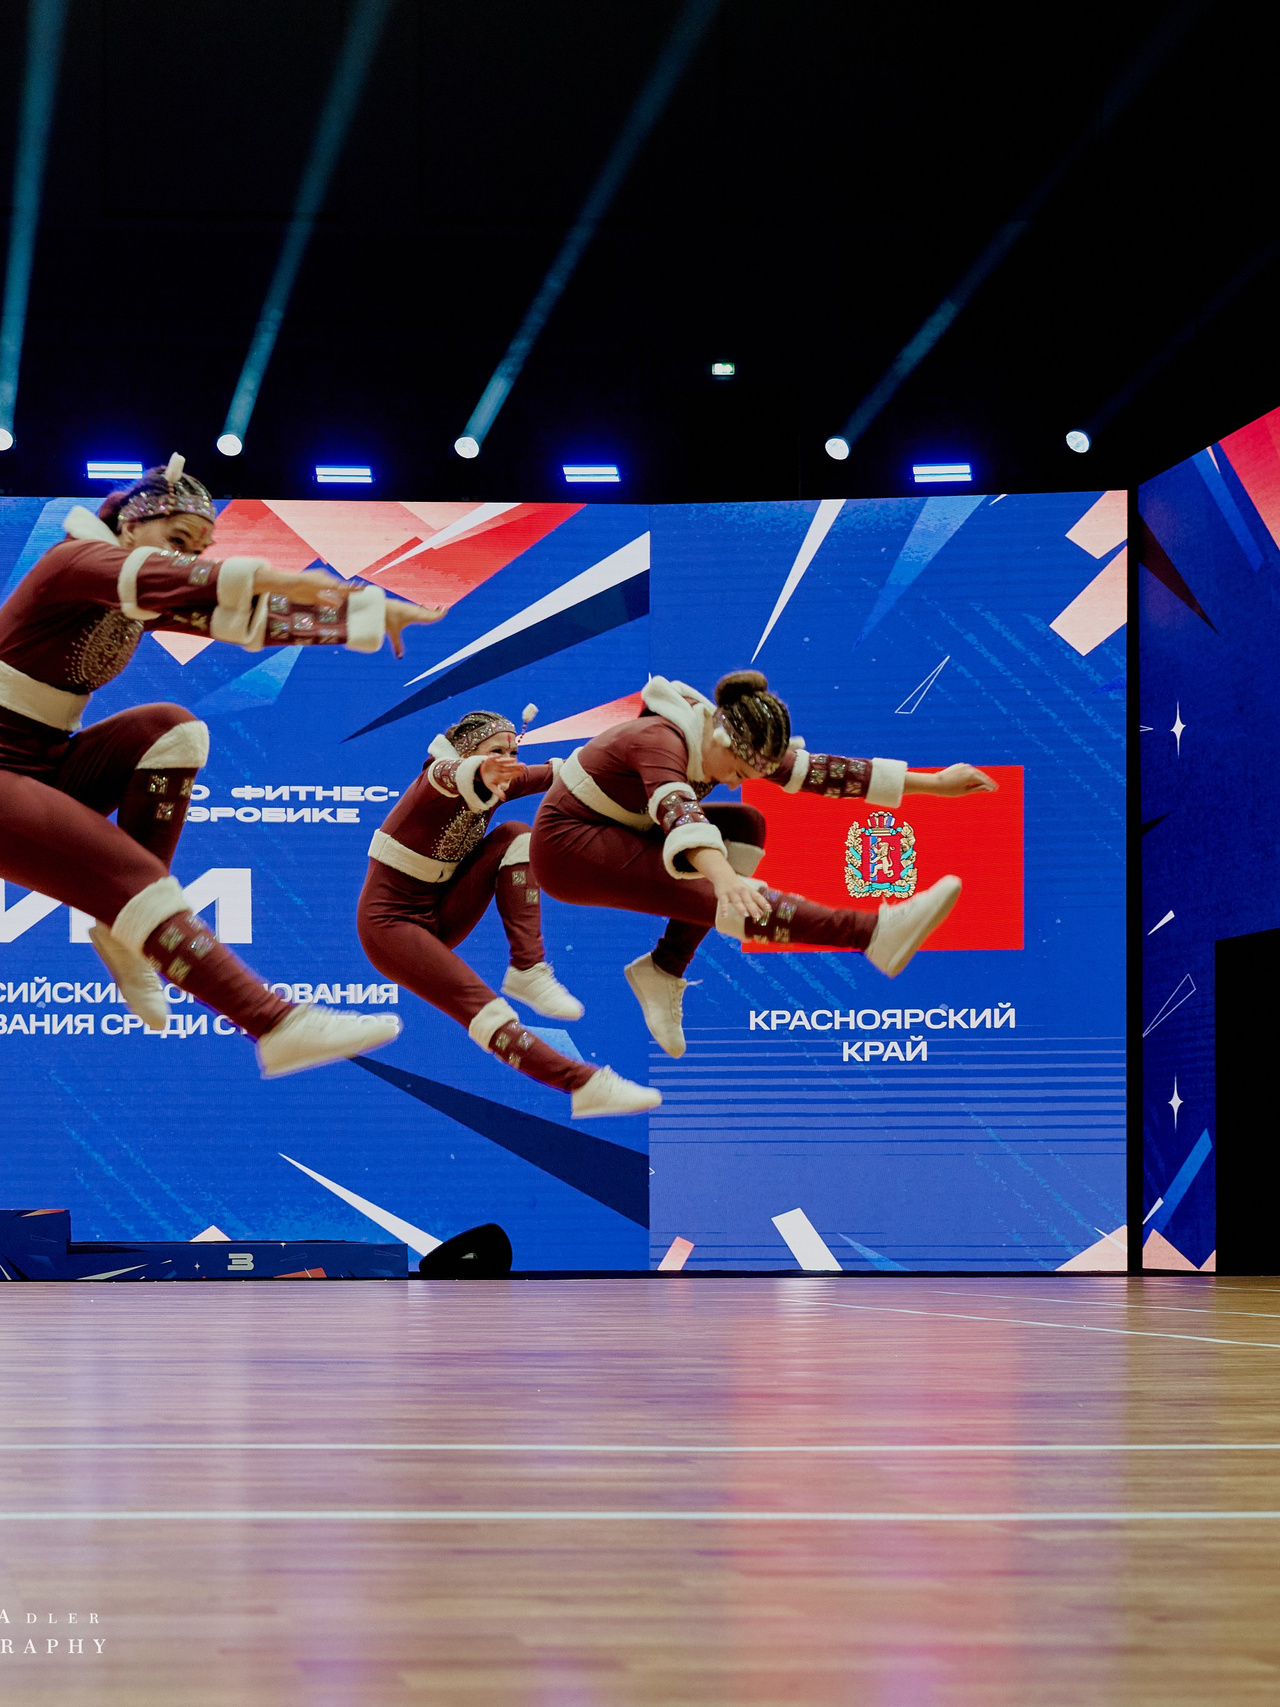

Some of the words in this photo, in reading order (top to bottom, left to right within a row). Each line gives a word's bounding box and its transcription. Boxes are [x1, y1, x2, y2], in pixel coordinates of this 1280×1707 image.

[231, 785, 400, 802] ФИТНЕС-
[184, 806, 360, 823] ЭРОБИКЕ
[749, 1002, 1016, 1031] КРАСНОЯРСКИЙ
[842, 1035, 928, 1062] КРАЙ
[227, 1252, 255, 1272] 3
